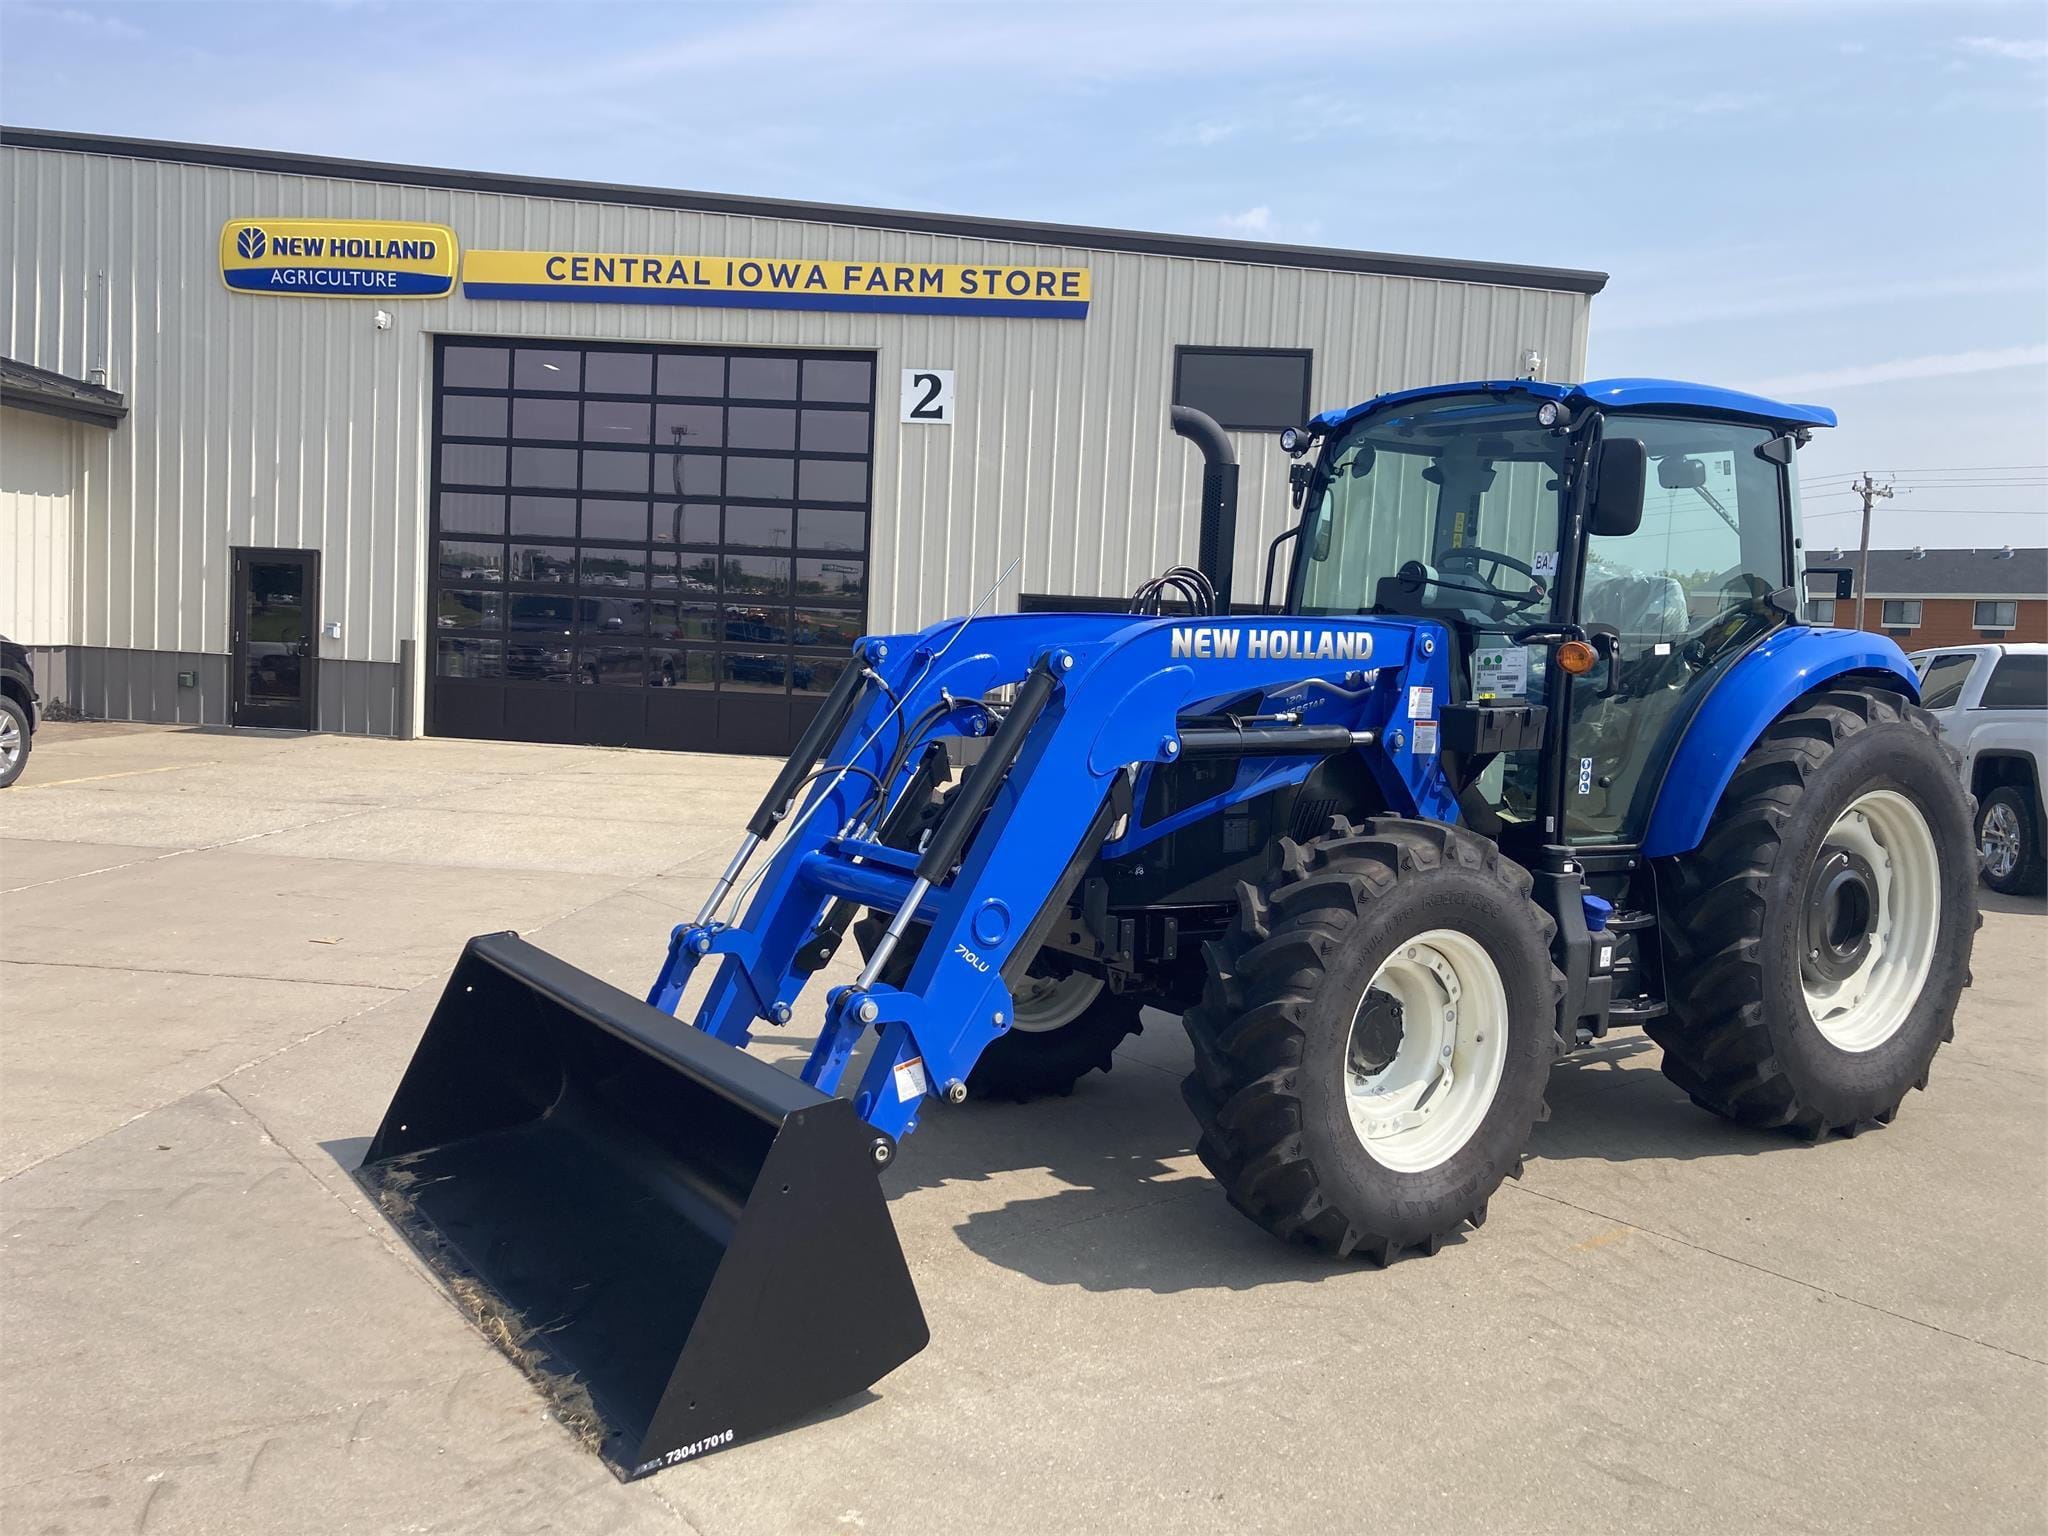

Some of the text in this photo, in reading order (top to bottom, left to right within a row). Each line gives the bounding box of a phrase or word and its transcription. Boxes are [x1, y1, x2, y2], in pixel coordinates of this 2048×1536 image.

[272, 236, 436, 260] NEW HOLLAND
[271, 269, 397, 288] AGRICULTURE
[546, 256, 1081, 297] CENTRAL IOWA FARM STORE
[910, 373, 944, 419] 2
[1170, 628, 1374, 660] NEW HOLLAND
[954, 943, 990, 972] 710LU
